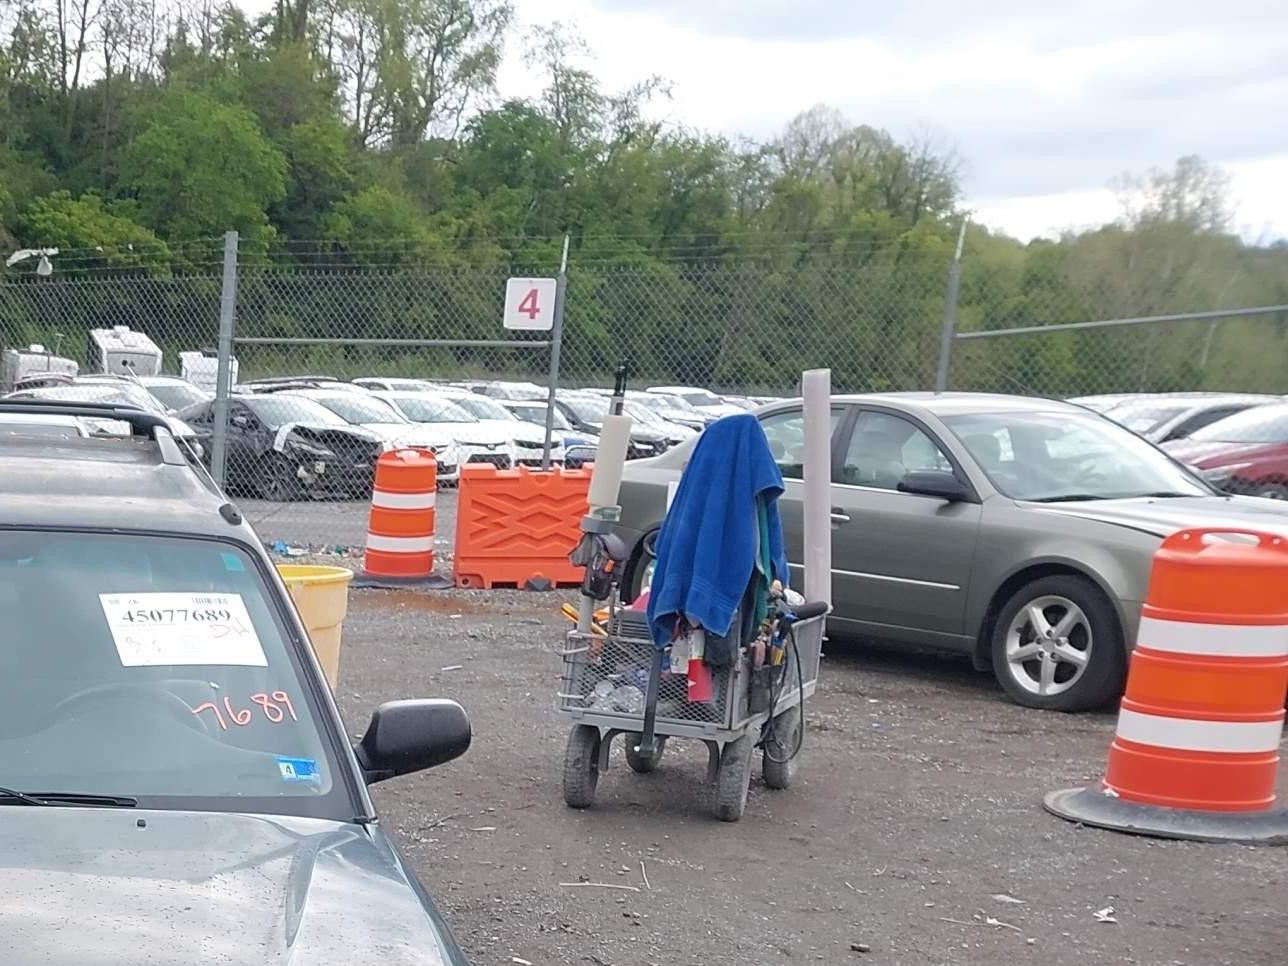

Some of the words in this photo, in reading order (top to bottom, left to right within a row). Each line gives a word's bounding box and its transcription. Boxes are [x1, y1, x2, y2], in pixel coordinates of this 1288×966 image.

[518, 289, 540, 319] 4
[122, 609, 231, 623] 45077689
[191, 690, 298, 731] 7689
